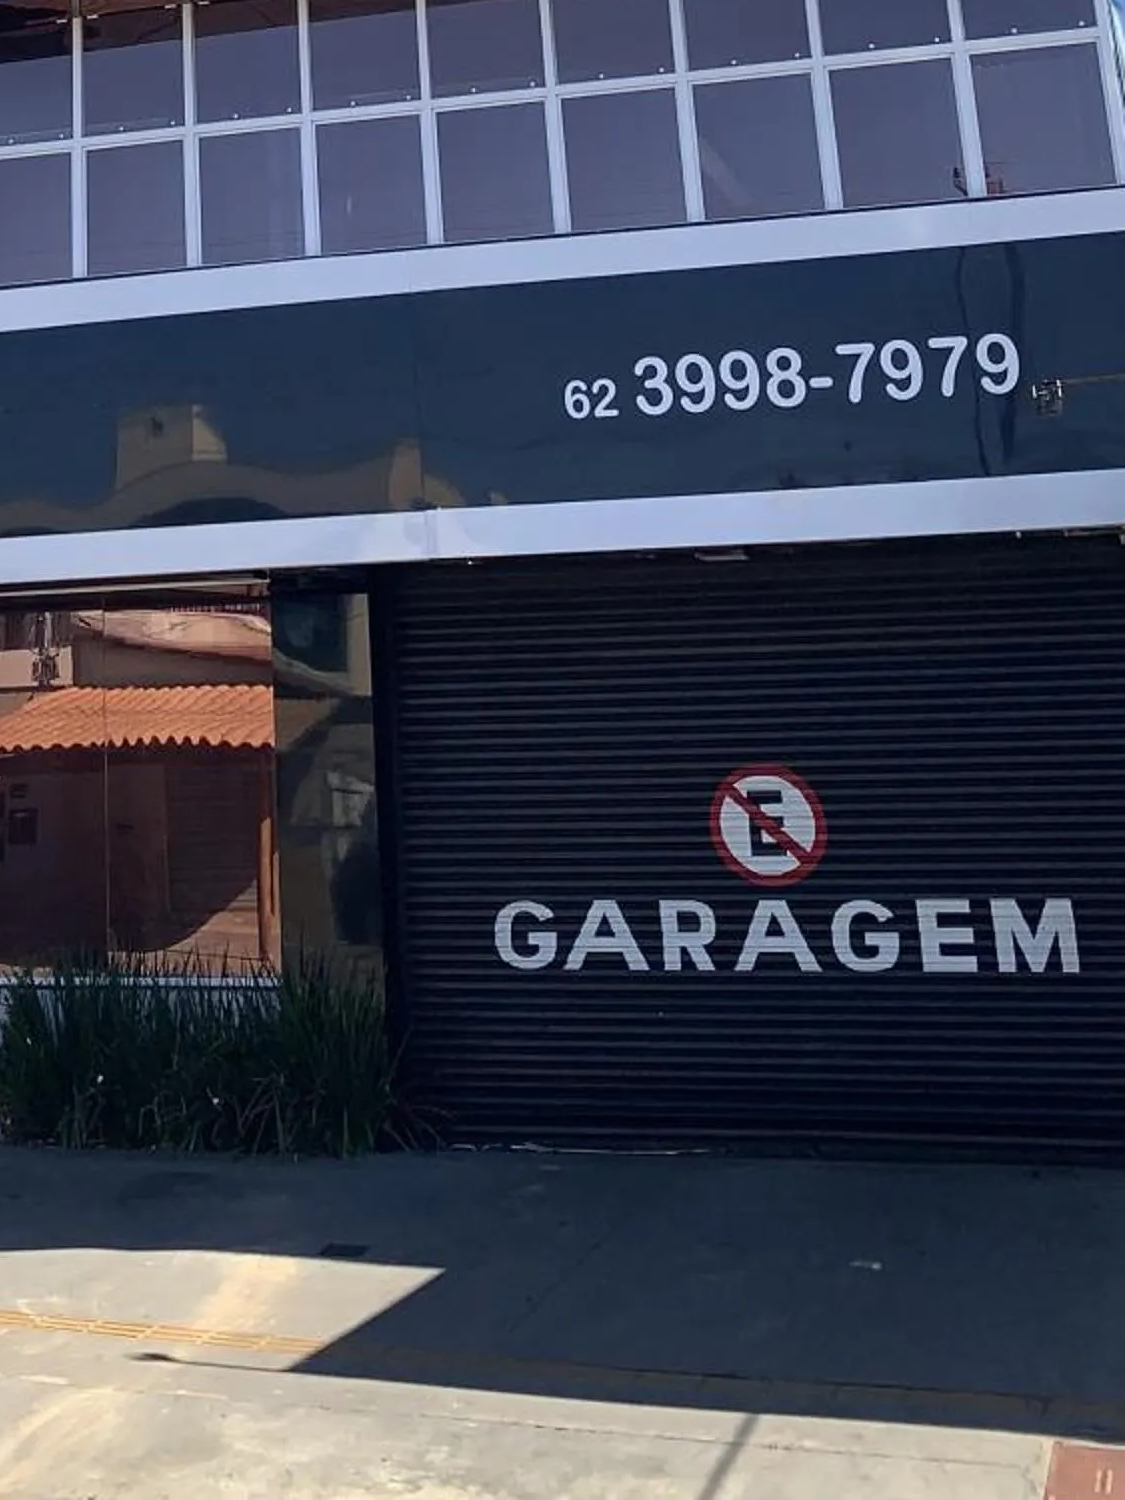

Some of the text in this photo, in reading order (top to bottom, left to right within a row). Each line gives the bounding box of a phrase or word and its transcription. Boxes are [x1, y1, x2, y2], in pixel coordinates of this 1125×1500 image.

[563, 332, 1021, 420] 62 3998-7979
[493, 898, 1081, 973] GARAGEM
